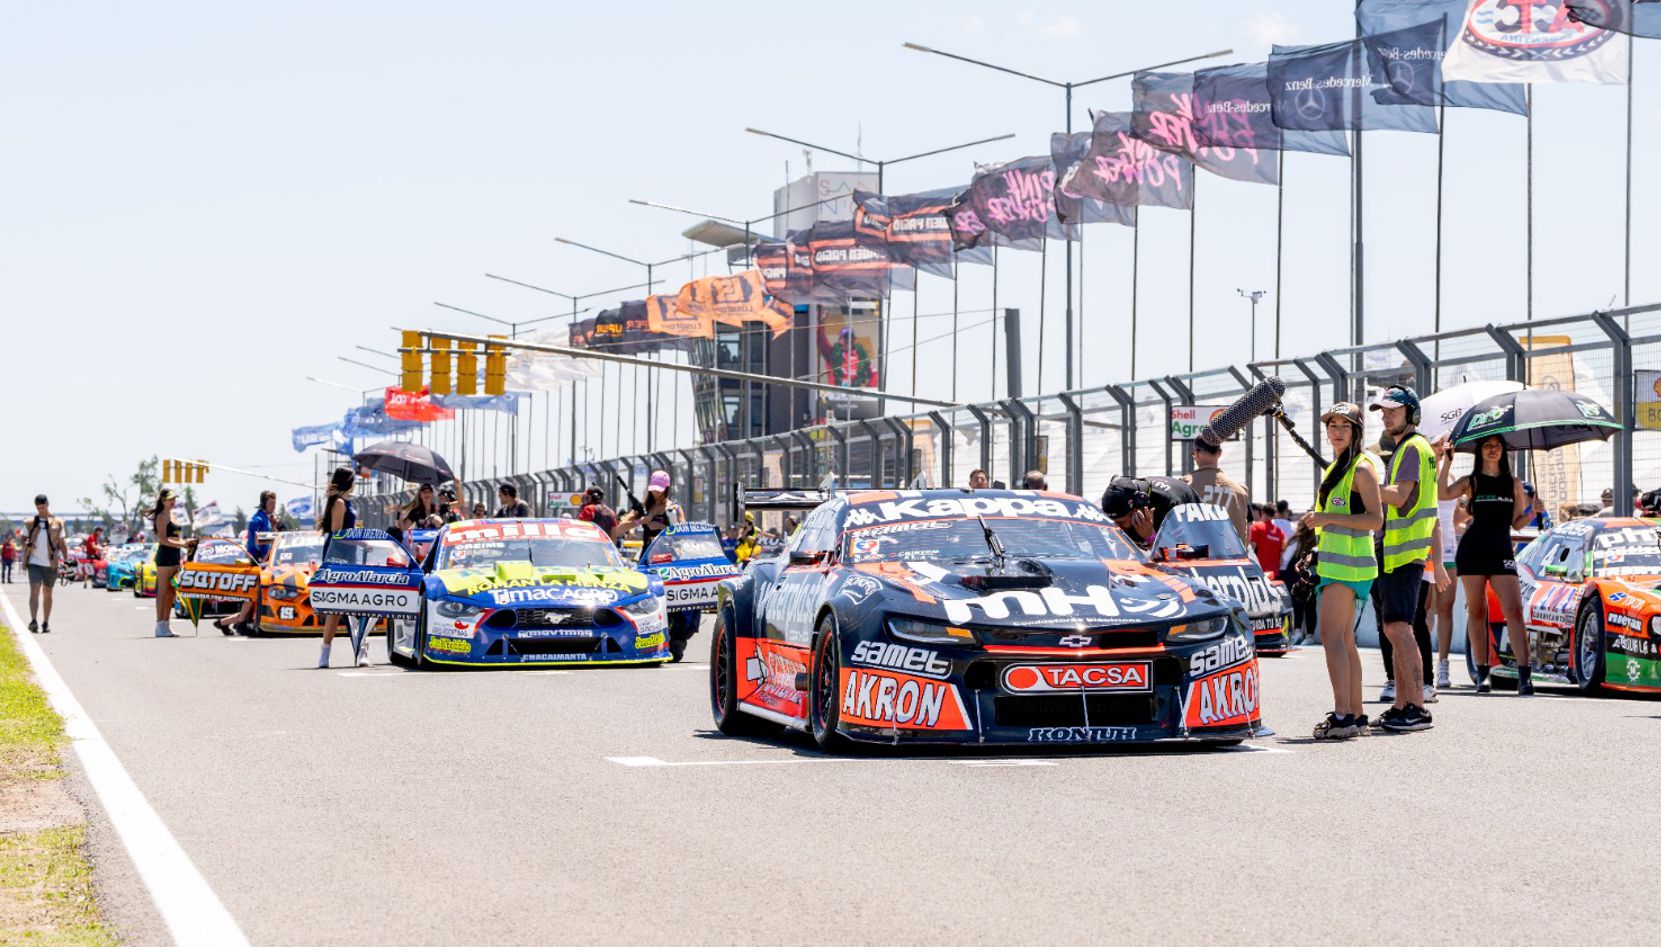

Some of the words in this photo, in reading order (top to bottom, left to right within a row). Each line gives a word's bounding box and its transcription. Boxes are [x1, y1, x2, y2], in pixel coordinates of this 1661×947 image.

[1172, 410, 1196, 419] Shell
[879, 498, 1071, 520] Kappa
[174, 570, 257, 592] SQTOFF
[321, 569, 410, 584] AgroAlarcia
[669, 564, 738, 581] AgroAlarc
[468, 579, 535, 595] ROMAN
[850, 640, 949, 674] samet
[1189, 635, 1253, 677] same
[1047, 667, 1143, 686] TACSA
[842, 671, 947, 727] AKRON
